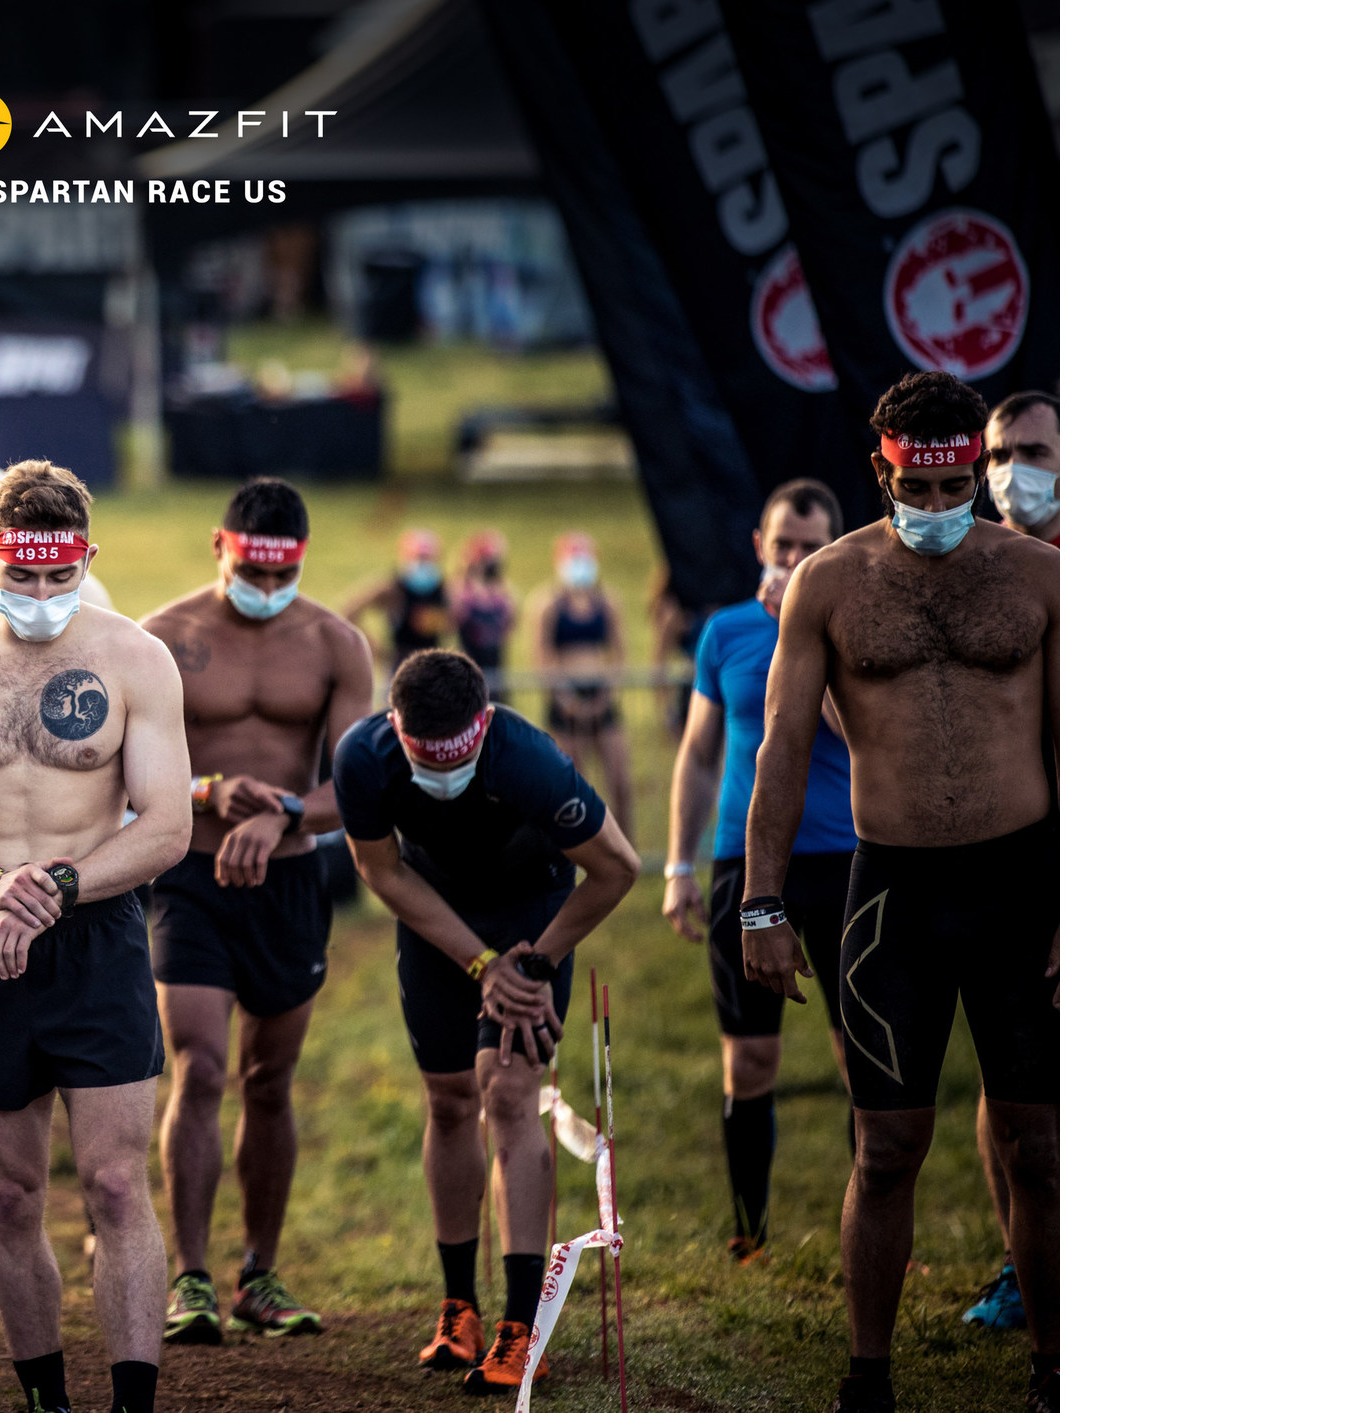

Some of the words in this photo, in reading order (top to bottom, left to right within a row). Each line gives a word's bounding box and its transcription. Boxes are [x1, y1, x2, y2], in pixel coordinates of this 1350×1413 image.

[912, 451, 955, 464] 4538
[16, 530, 74, 544] SPARTAN
[16, 547, 59, 560] 4935
